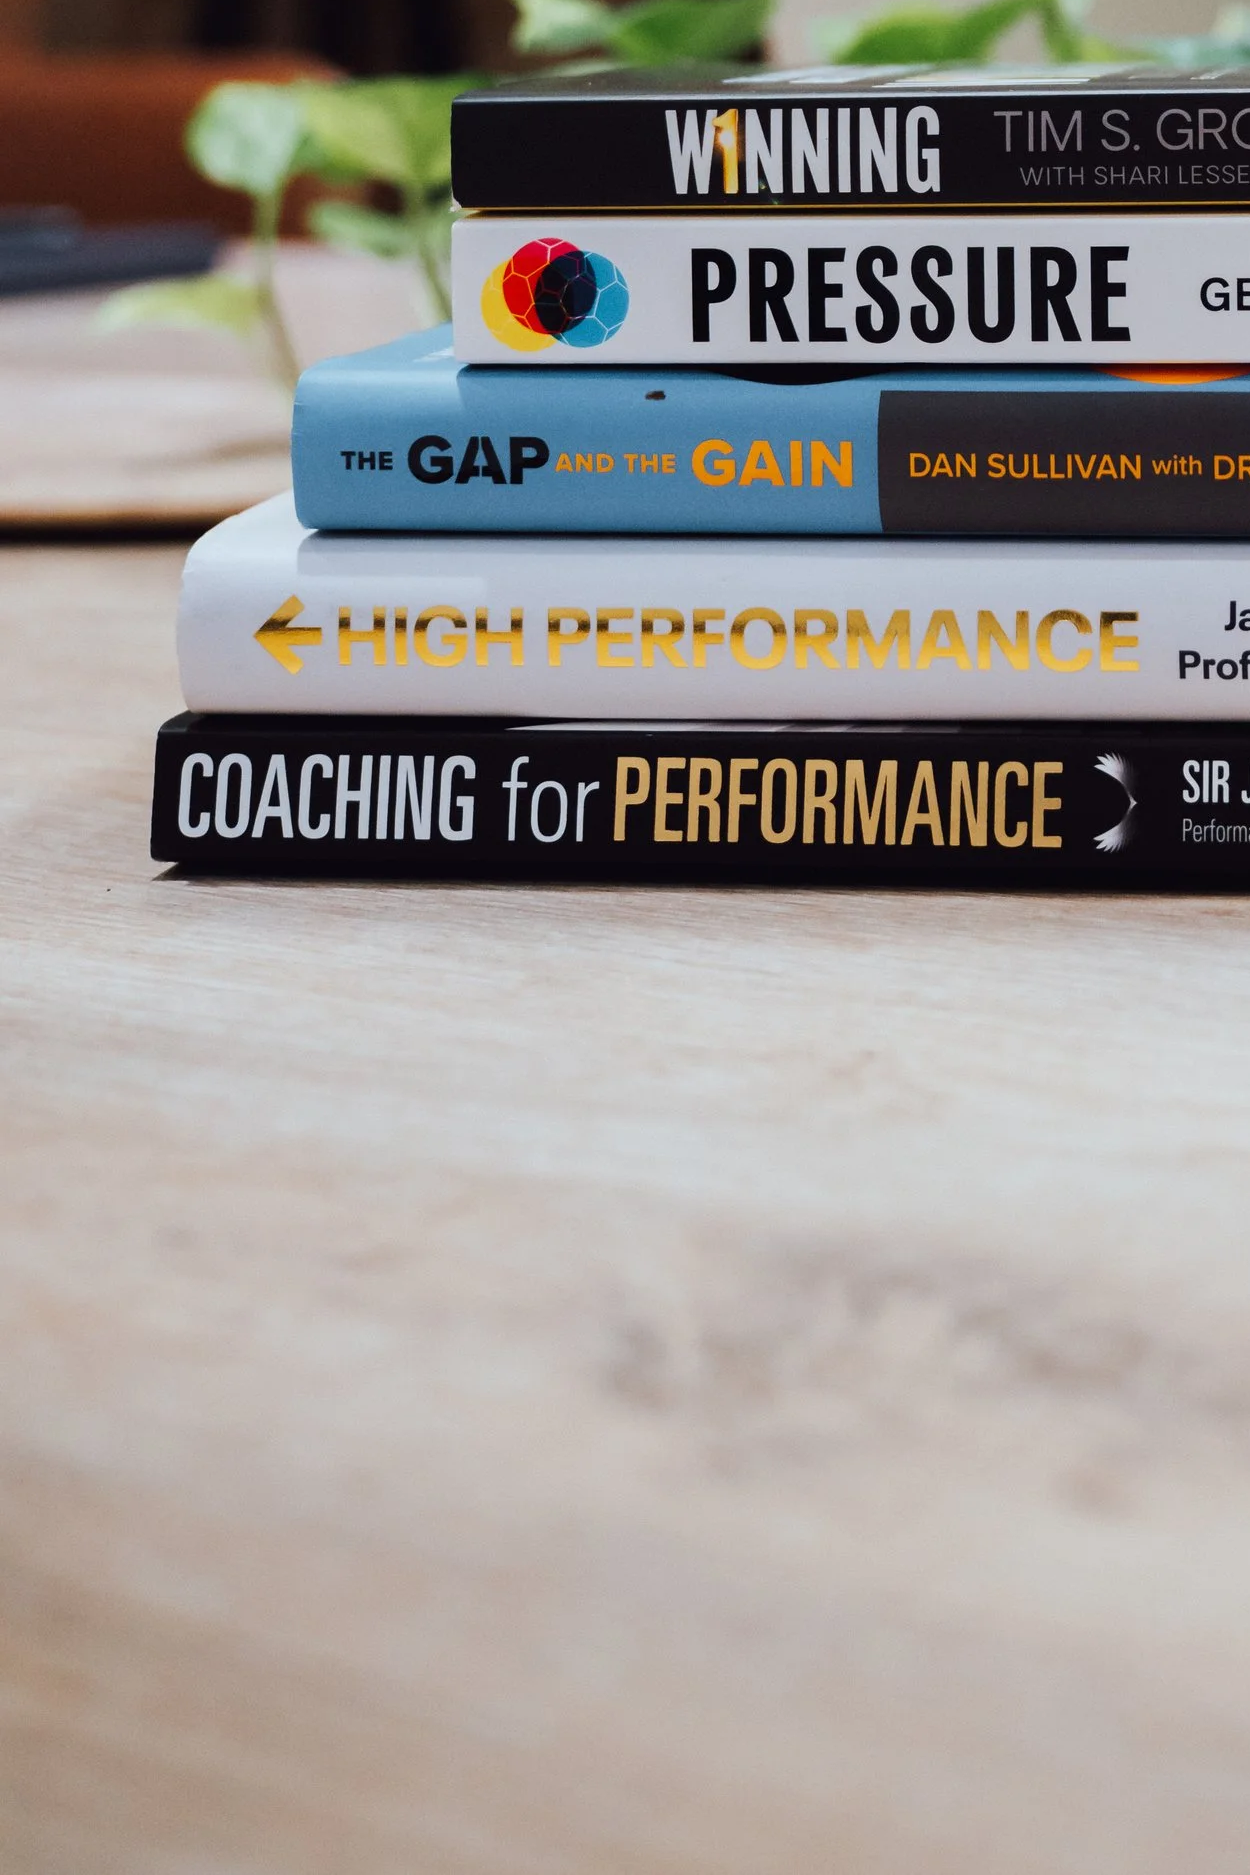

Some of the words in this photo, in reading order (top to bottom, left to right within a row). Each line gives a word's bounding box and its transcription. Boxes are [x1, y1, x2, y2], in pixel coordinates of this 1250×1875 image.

[994, 110, 1082, 152] TIM
[1101, 109, 1140, 151] S.
[1020, 167, 1084, 185] WITH
[1095, 166, 1168, 185] SHARI
[692, 245, 1131, 343] PRESSURE
[341, 451, 393, 470] THE
[408, 435, 549, 484] GAP
[555, 453, 614, 472] AND
[624, 453, 675, 473] THE
[692, 439, 853, 487] GAIN
[910, 453, 976, 477] DAN
[988, 453, 1141, 479] SULLIVAN
[1152, 455, 1202, 475] with
[338, 607, 523, 666] HIGH
[548, 608, 1138, 671] PERFORMANCE
[178, 753, 476, 841] COACHING
[502, 756, 599, 842] for
[614, 757, 1063, 847] PERFORMANCE
[1183, 760, 1229, 803] SIR
